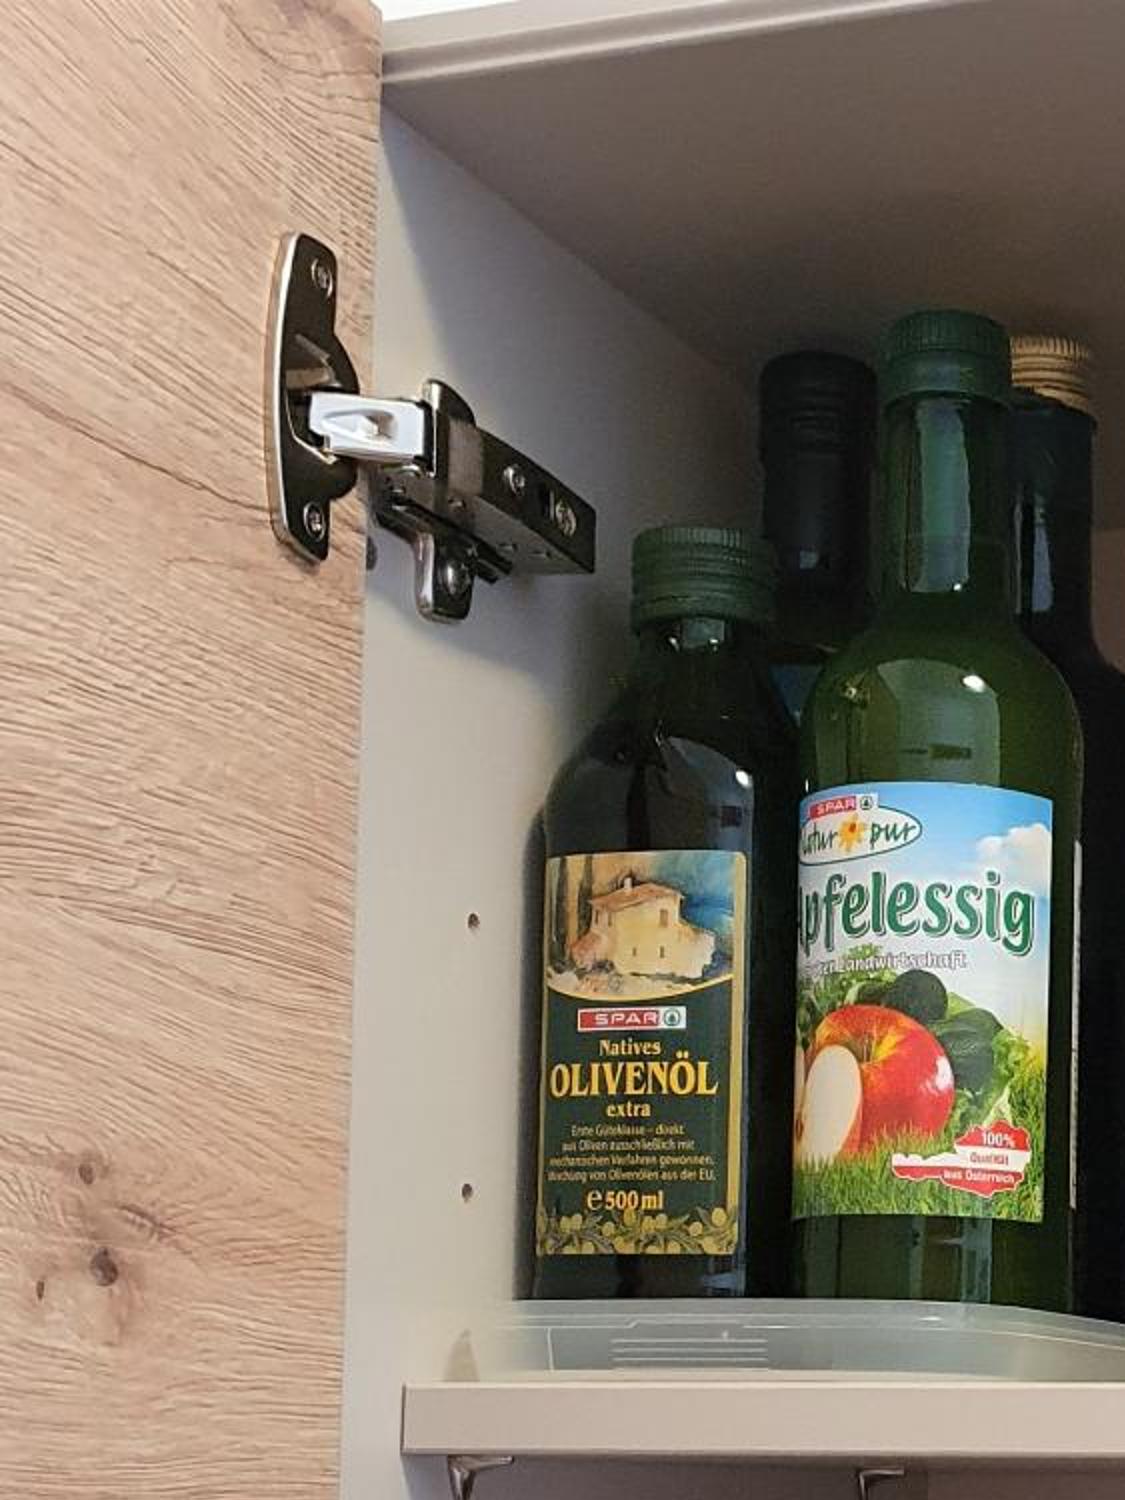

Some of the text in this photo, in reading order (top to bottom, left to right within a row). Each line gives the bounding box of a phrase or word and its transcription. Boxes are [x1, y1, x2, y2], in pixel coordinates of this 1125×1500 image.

[816, 797, 855, 815] SPAR
[870, 821, 916, 850] pur
[799, 870, 1034, 956] pfelessig
[594, 1011, 658, 1026] SPAR
[599, 1037, 661, 1057] Natives
[551, 1051, 719, 1098] OLIVENÖL
[606, 1101, 651, 1118] extra
[981, 1130, 1016, 1149] 100%
